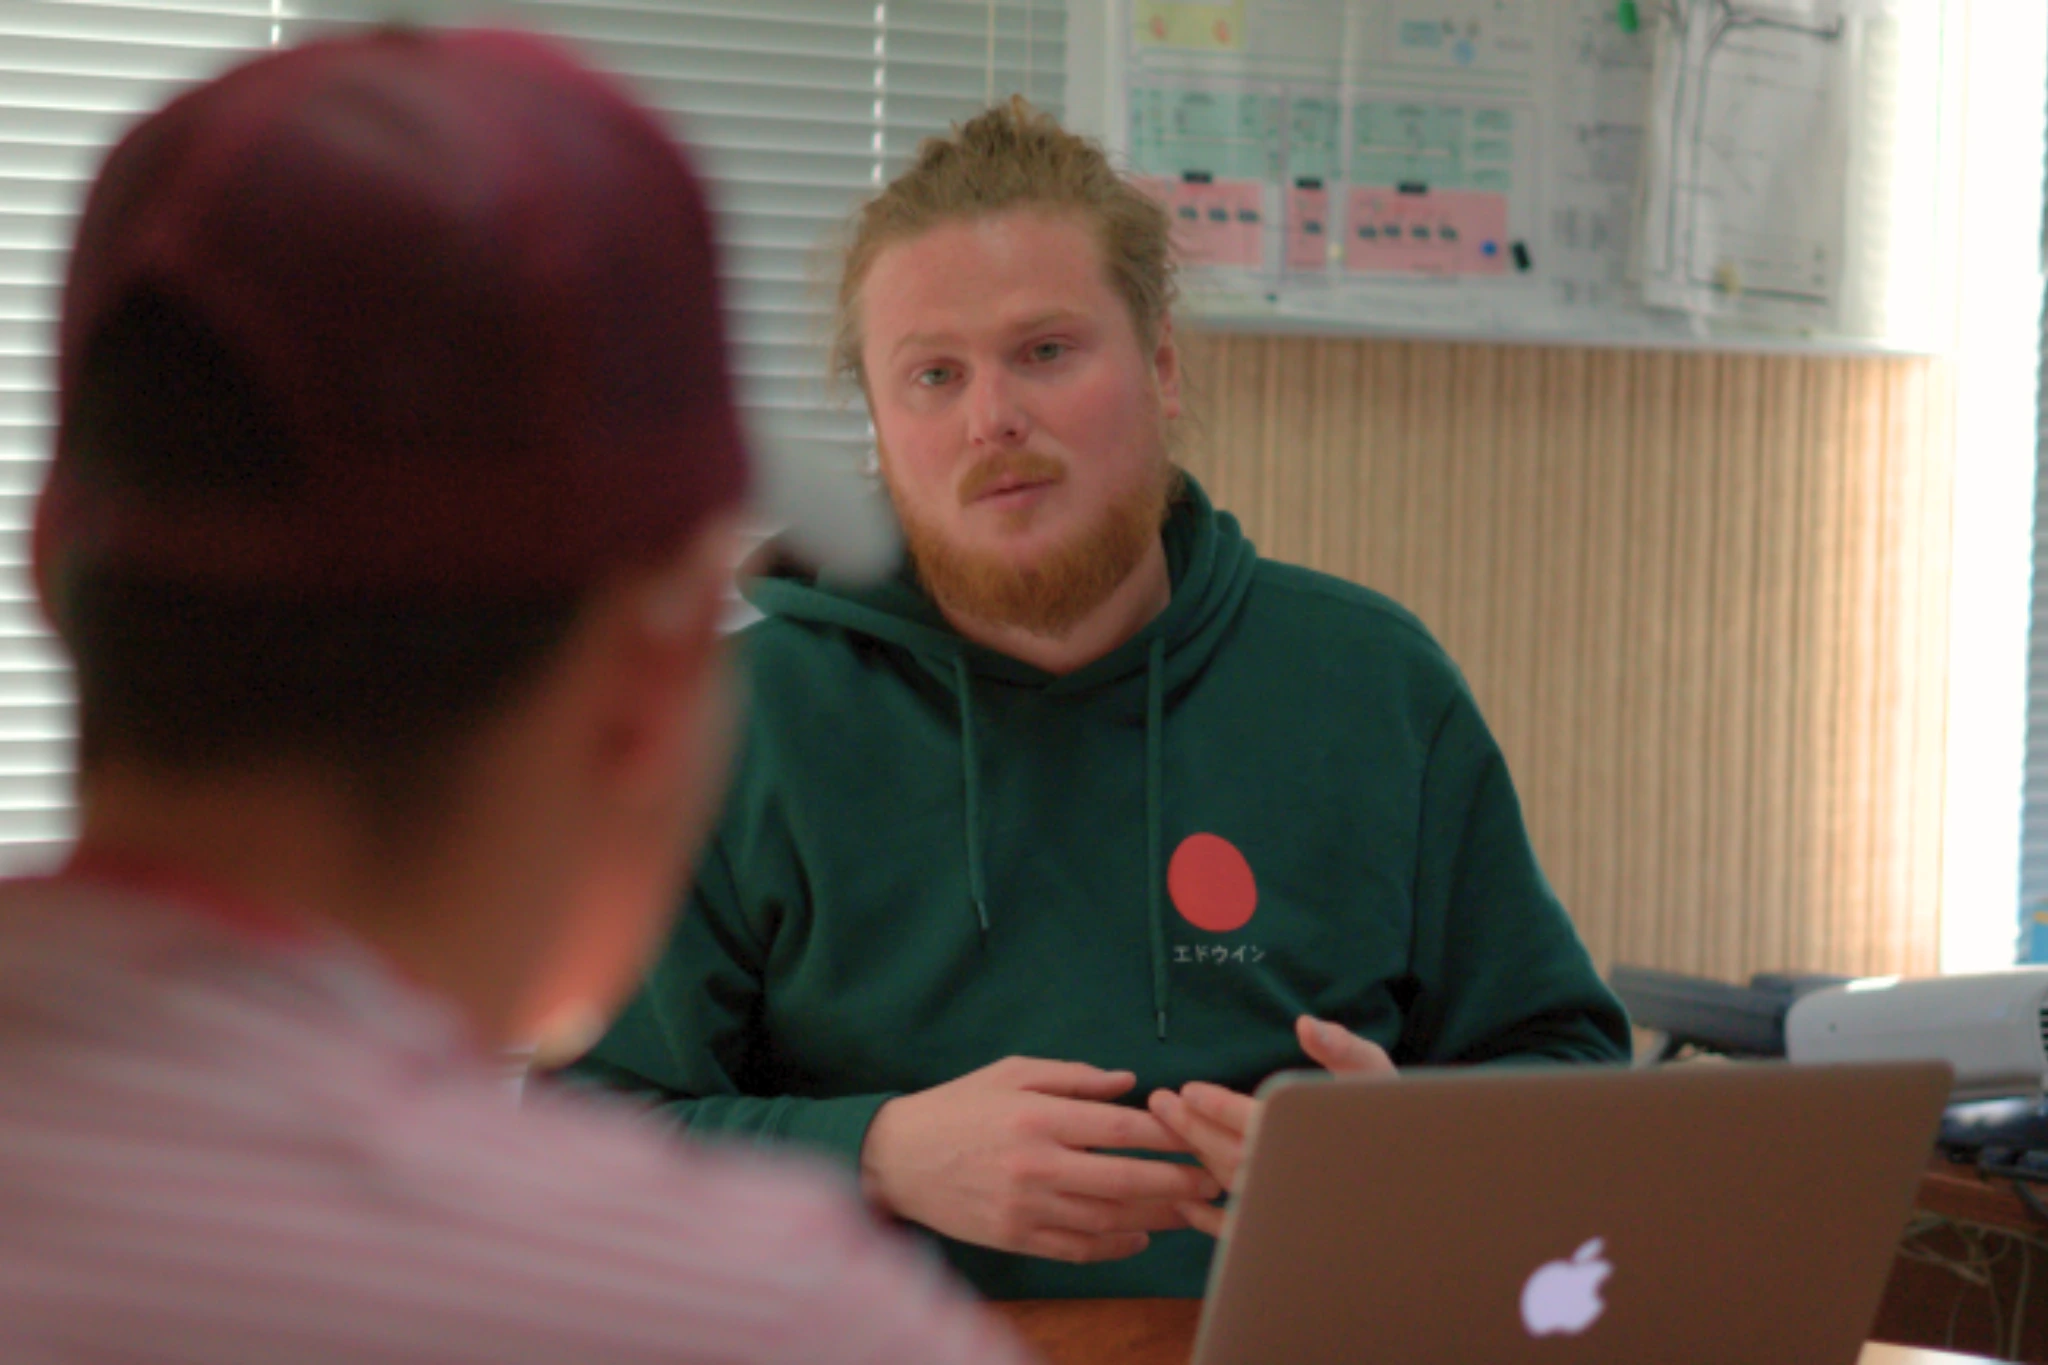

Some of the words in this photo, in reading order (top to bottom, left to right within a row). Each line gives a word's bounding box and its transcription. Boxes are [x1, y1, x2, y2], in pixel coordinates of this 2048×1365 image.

[1174, 944, 1265, 965] エドウイン
